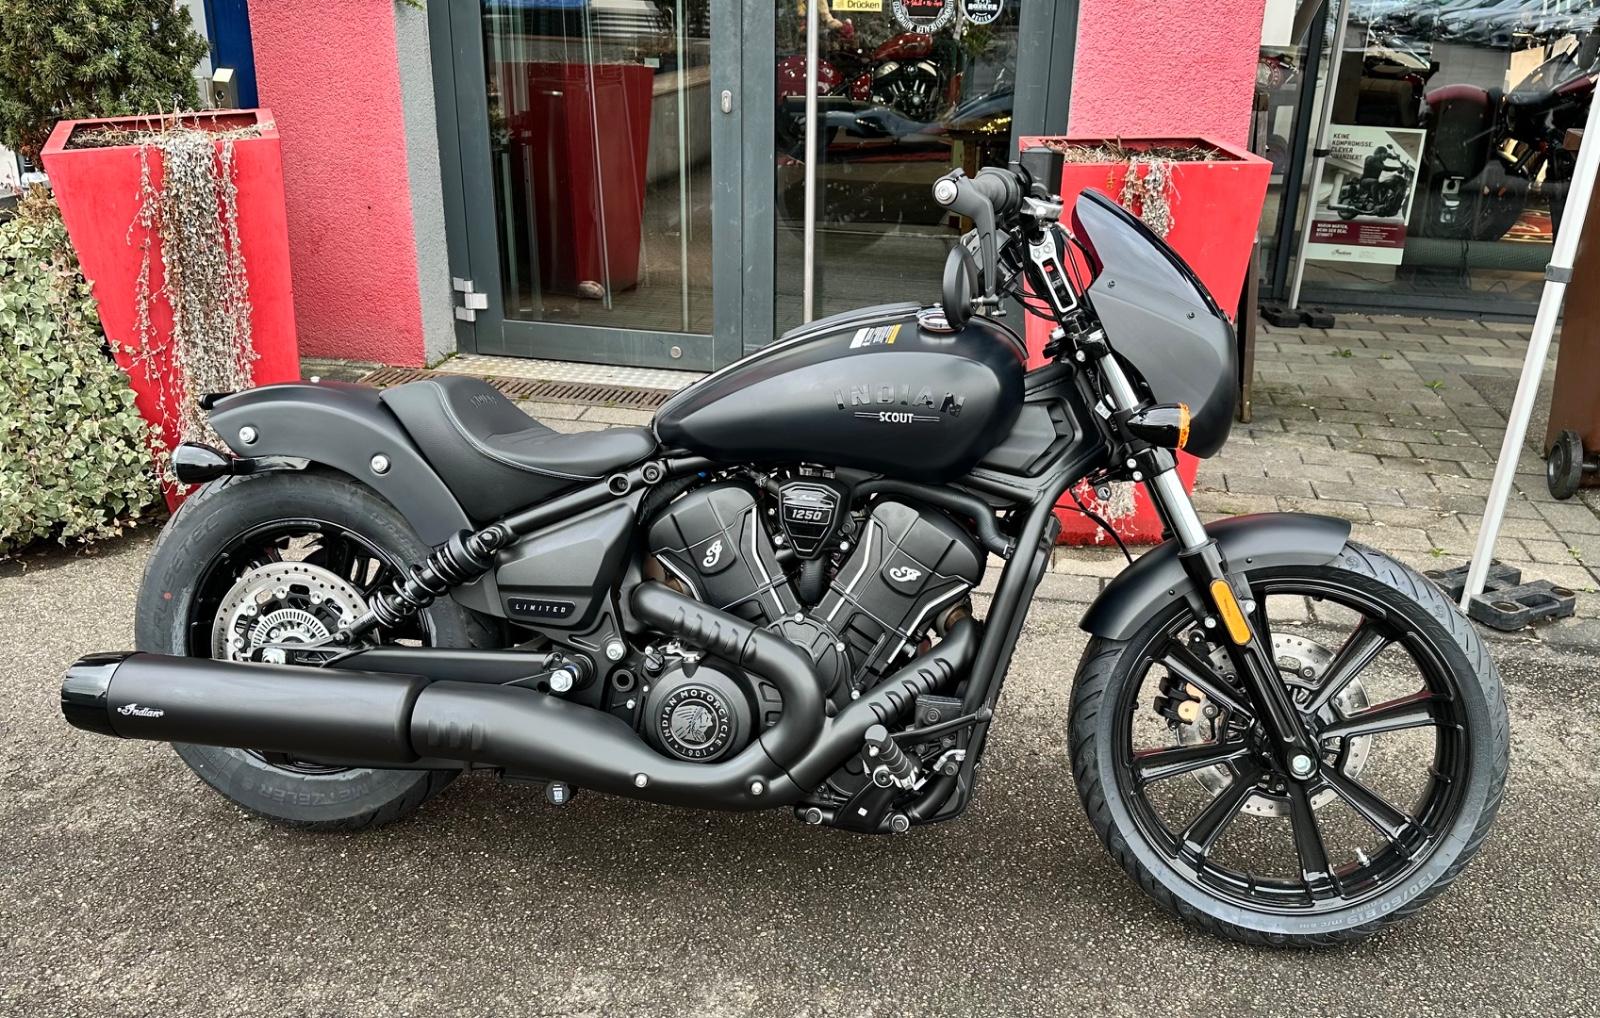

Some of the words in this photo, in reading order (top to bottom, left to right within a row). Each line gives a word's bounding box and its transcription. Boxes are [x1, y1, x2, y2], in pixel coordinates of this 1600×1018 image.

[847, 0, 880, 9] Drücken
[833, 383, 966, 417] INDIAN
[879, 411, 914, 424] SCOUT
[792, 509, 822, 520] 1250
[515, 603, 567, 613] LIMITED
[117, 703, 164, 718] Indian
[661, 697, 678, 742] INDIAN
[680, 689, 729, 746] MOTORCYCLE
[682, 748, 708, 757] 1901
[1380, 872, 1435, 911] 130/60
